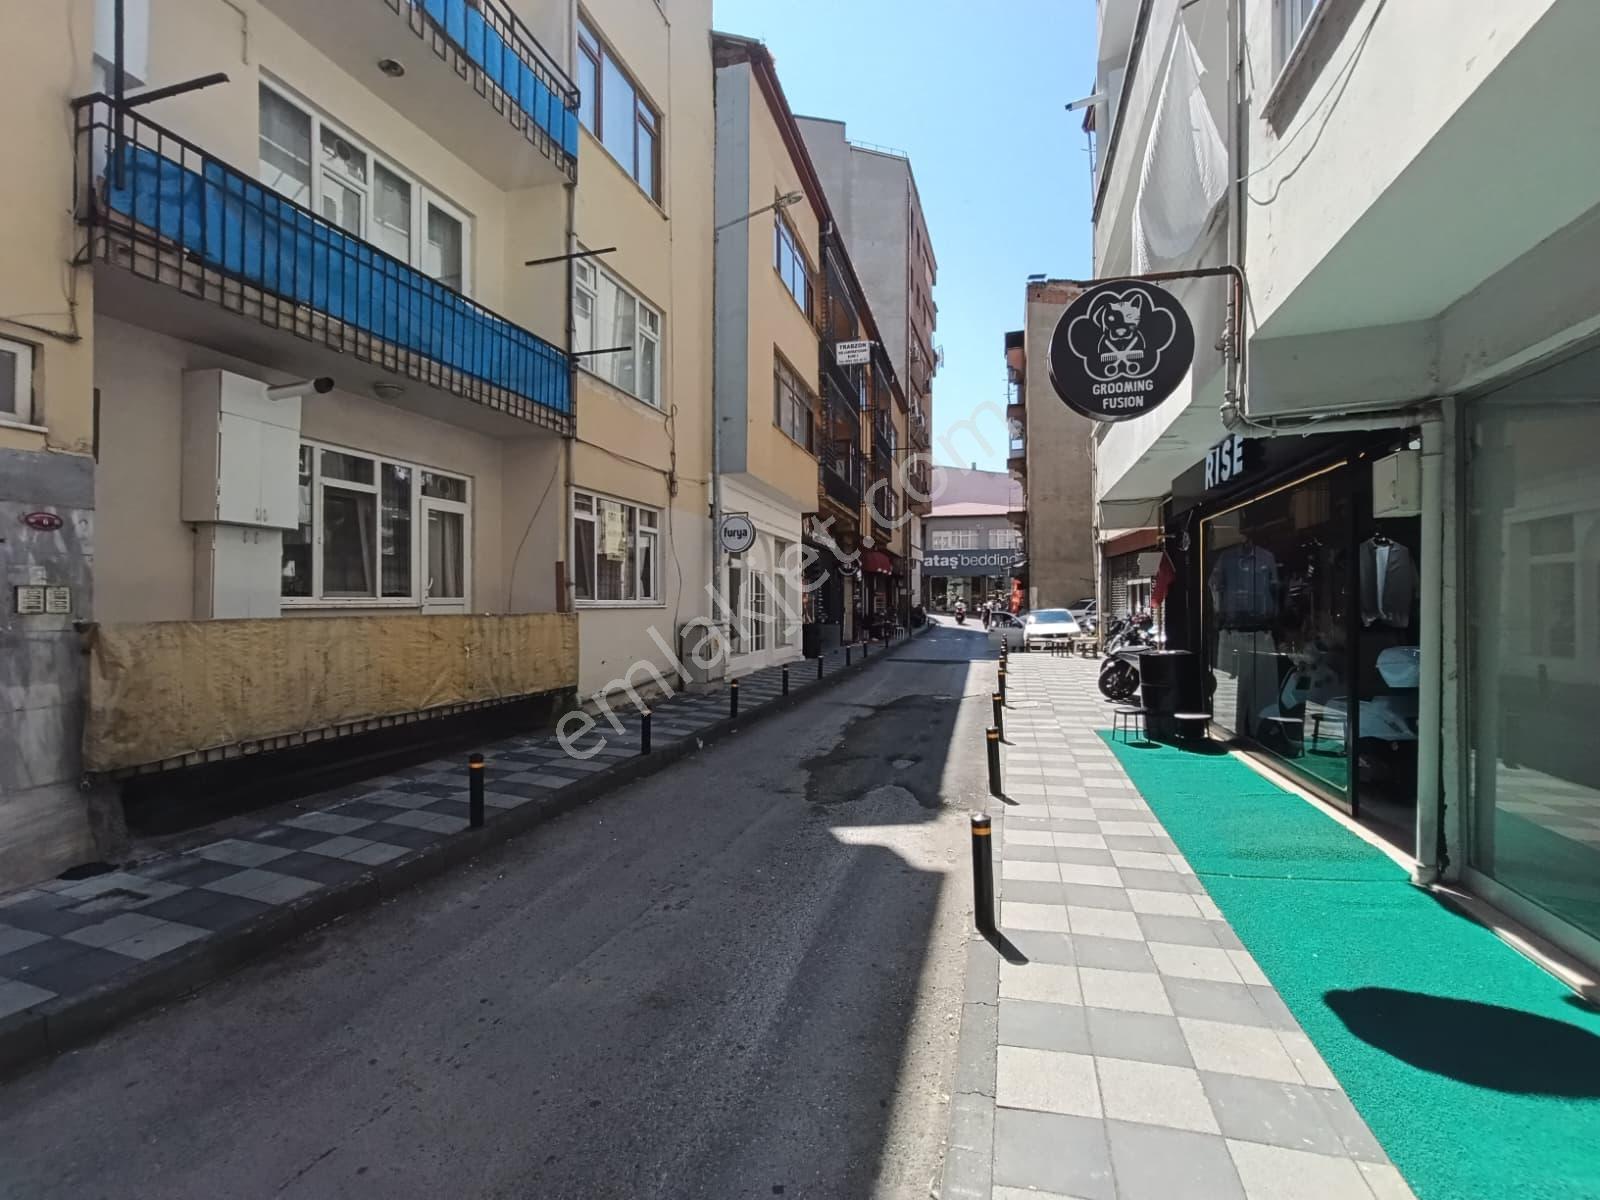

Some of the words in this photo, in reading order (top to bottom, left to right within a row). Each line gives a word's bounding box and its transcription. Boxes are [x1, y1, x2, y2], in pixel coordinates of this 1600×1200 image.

[1092, 379, 1154, 396] GROOMING
[1102, 395, 1144, 410] FUSION
[1204, 434, 1244, 491] RISE
[724, 527, 747, 539] furya
